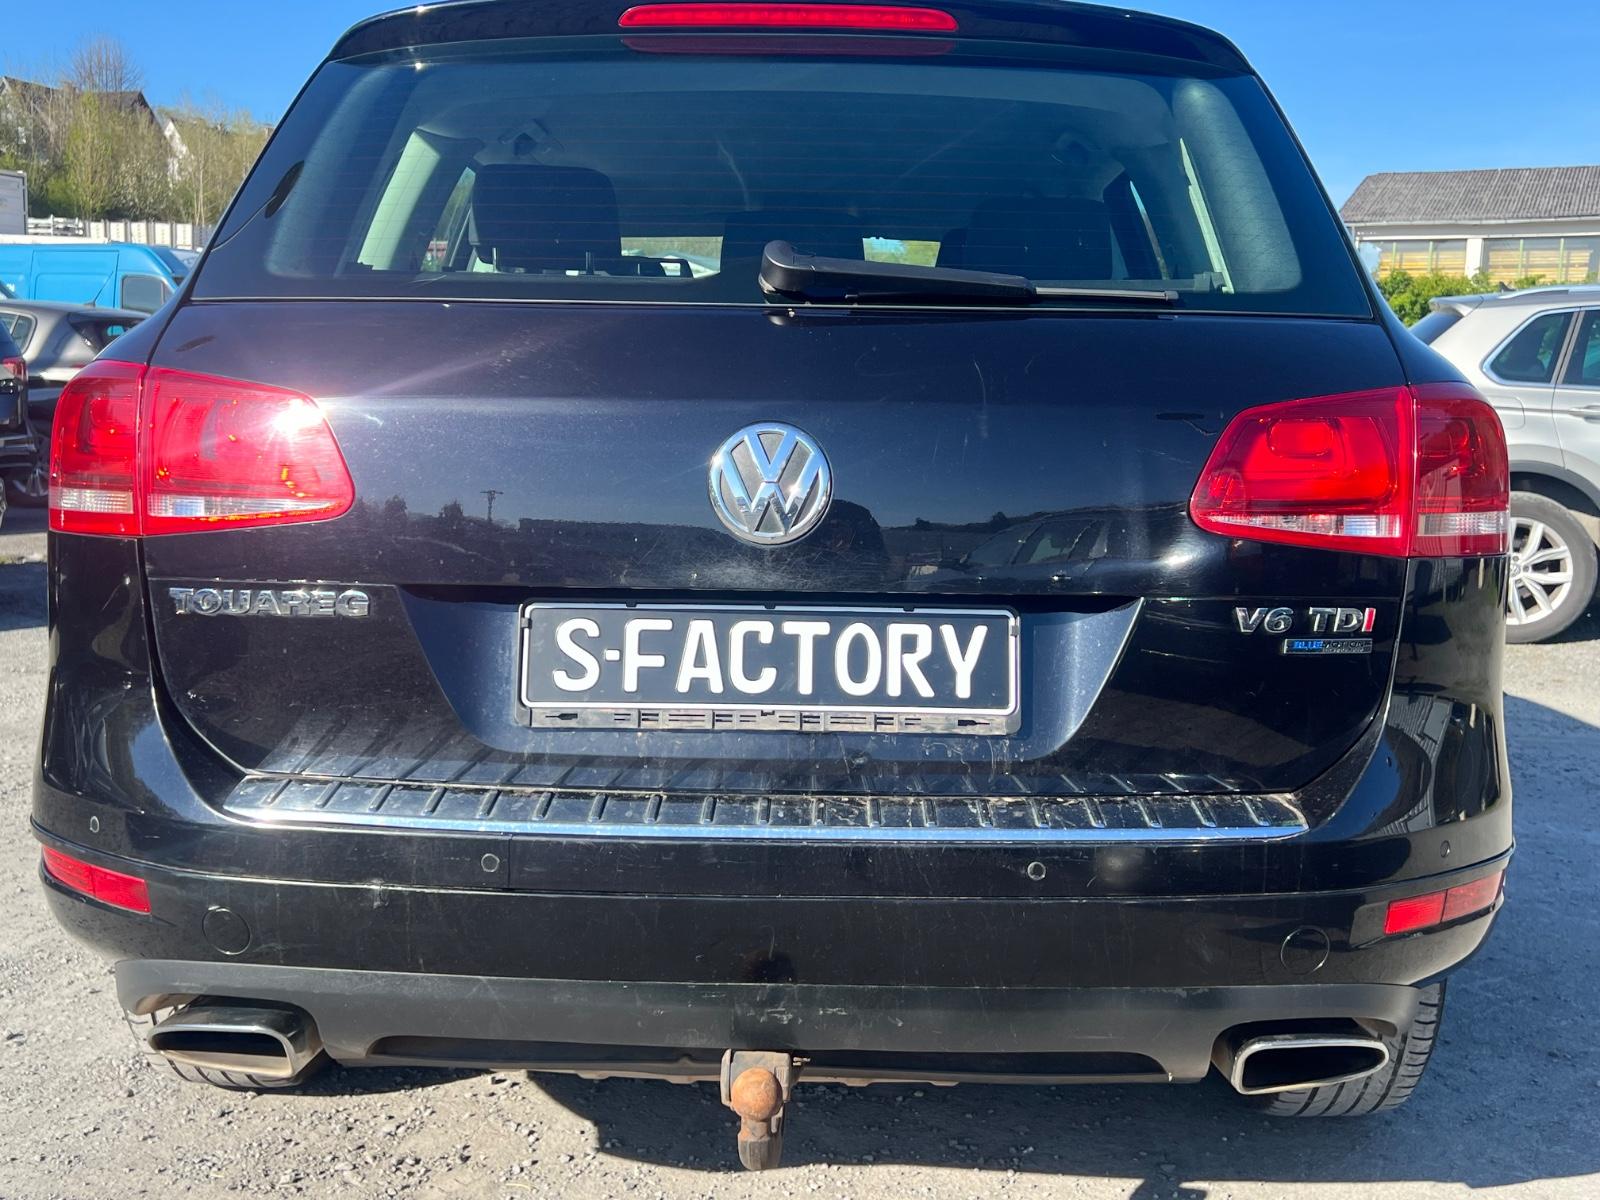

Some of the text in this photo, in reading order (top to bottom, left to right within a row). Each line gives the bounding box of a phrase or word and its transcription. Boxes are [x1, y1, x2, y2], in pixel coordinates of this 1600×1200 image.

[711, 424, 829, 543] VW
[168, 586, 370, 617] TOUAREG
[1235, 606, 1377, 633] V6 TDI
[551, 617, 989, 700] S-FACTORY
